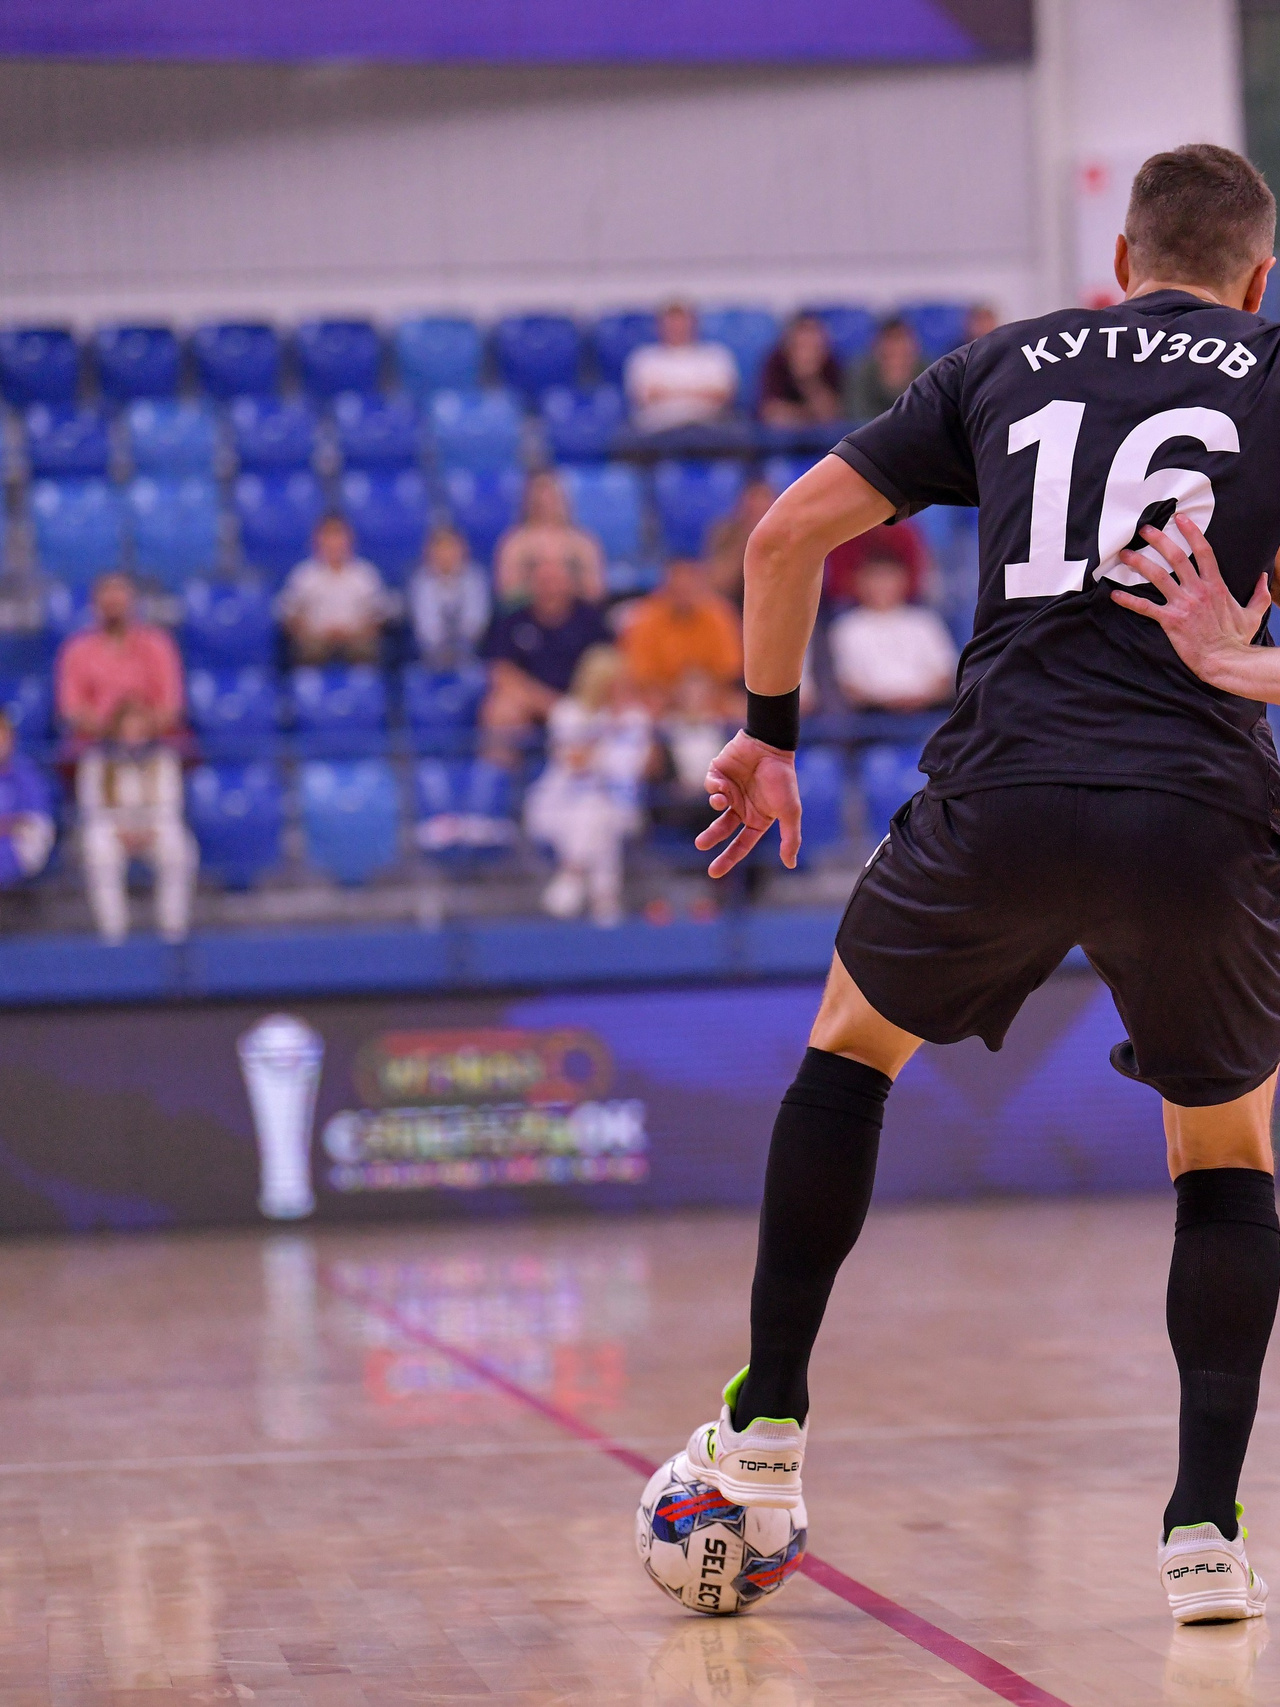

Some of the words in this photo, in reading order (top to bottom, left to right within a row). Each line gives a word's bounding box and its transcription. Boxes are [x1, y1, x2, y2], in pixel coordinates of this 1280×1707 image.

[1020, 326, 1257, 379] КУТУЗОВ
[1004, 399, 1241, 600] 16
[739, 1459, 800, 1473] TOP-FLE
[697, 1538, 727, 1610] SELECT
[1166, 1562, 1233, 1581] TOP-FLEX
